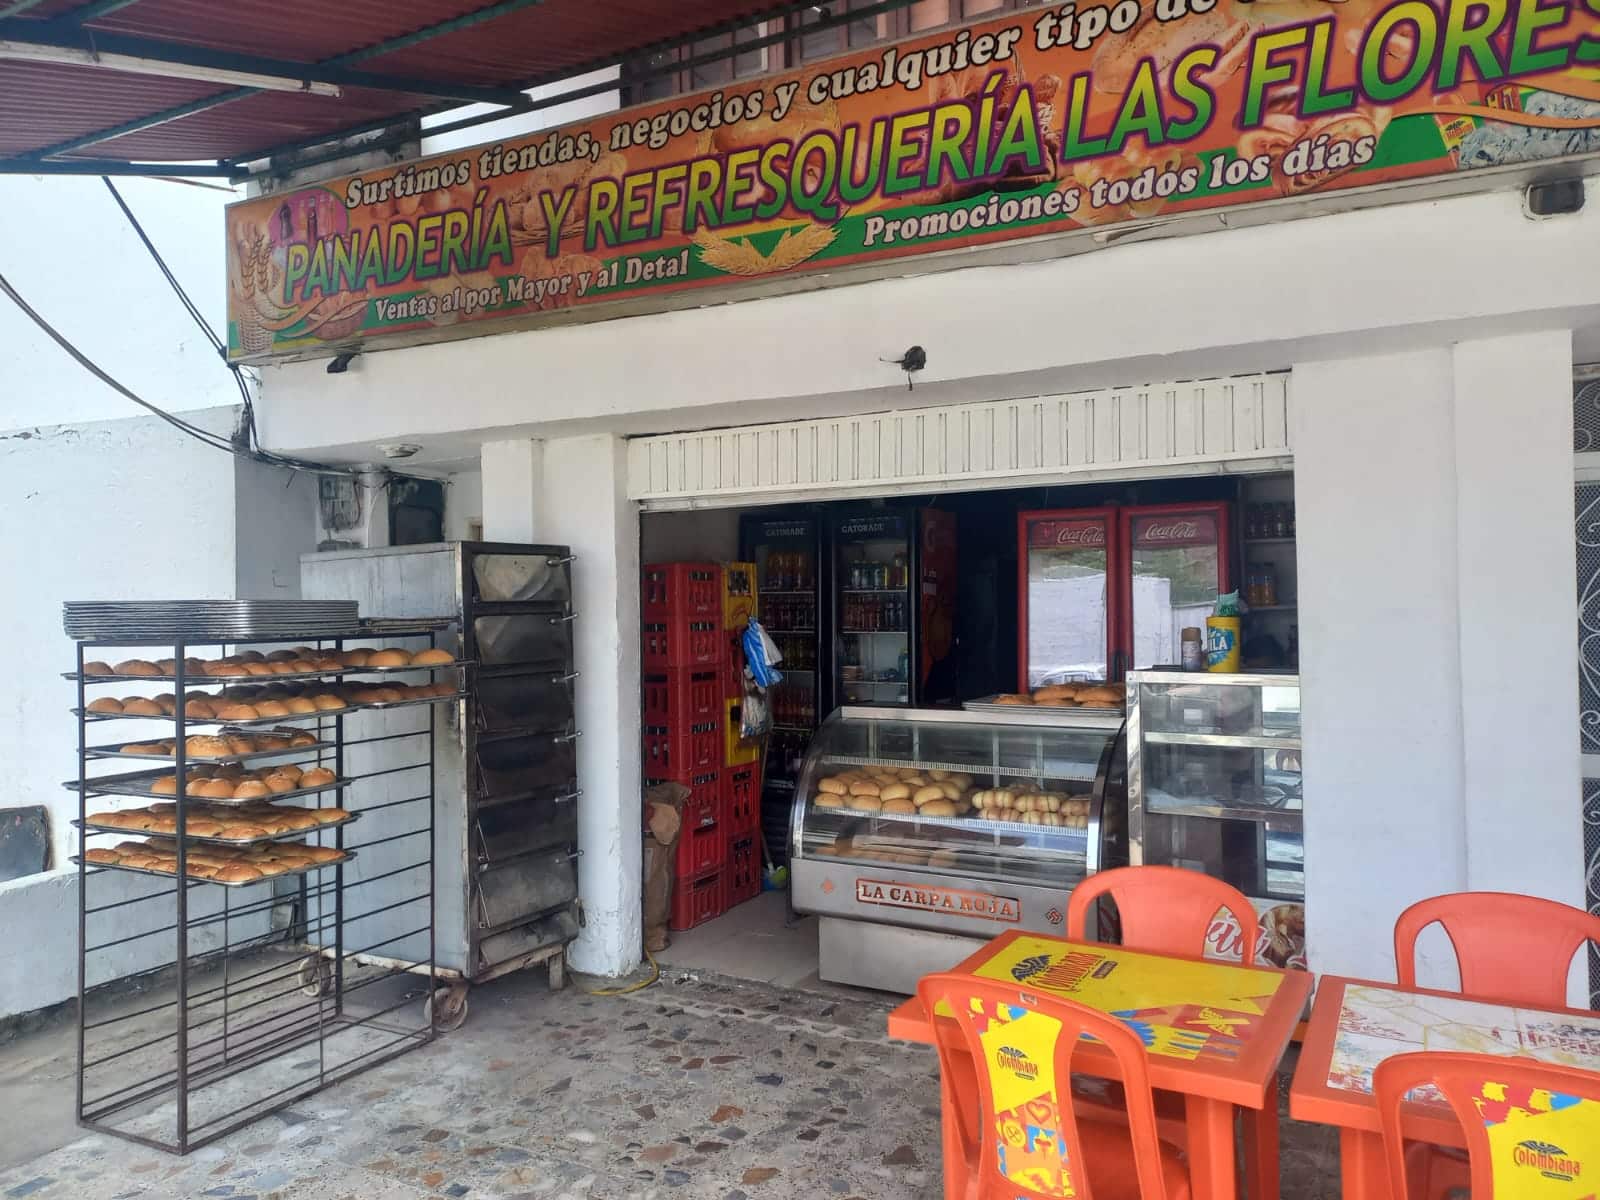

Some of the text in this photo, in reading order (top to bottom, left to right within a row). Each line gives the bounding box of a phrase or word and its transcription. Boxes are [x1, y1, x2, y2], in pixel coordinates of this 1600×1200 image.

[346, 160, 470, 209] Surtimos
[479, 131, 600, 180] tiendas,
[610, 90, 764, 149] negocios
[771, 81, 799, 122] y
[808, 26, 1022, 105] cualquier
[1034, 0, 1141, 50] tipo
[285, 187, 513, 301] PANADERÍA
[540, 184, 578, 258] Y
[584, 68, 1045, 251] REFRESQUERÍA
[1060, 44, 1220, 163] LAS
[863, 134, 1377, 247] Promociones todos los días
[375, 249, 690, 321] Ventas al por Mayor y al Detal
[841, 523, 885, 534] GATORADE
[862, 884, 1014, 916] LA CARPA ROJA
[996, 1051, 1039, 1077] Colombiana
[1513, 1146, 1581, 1177] Colombiana
